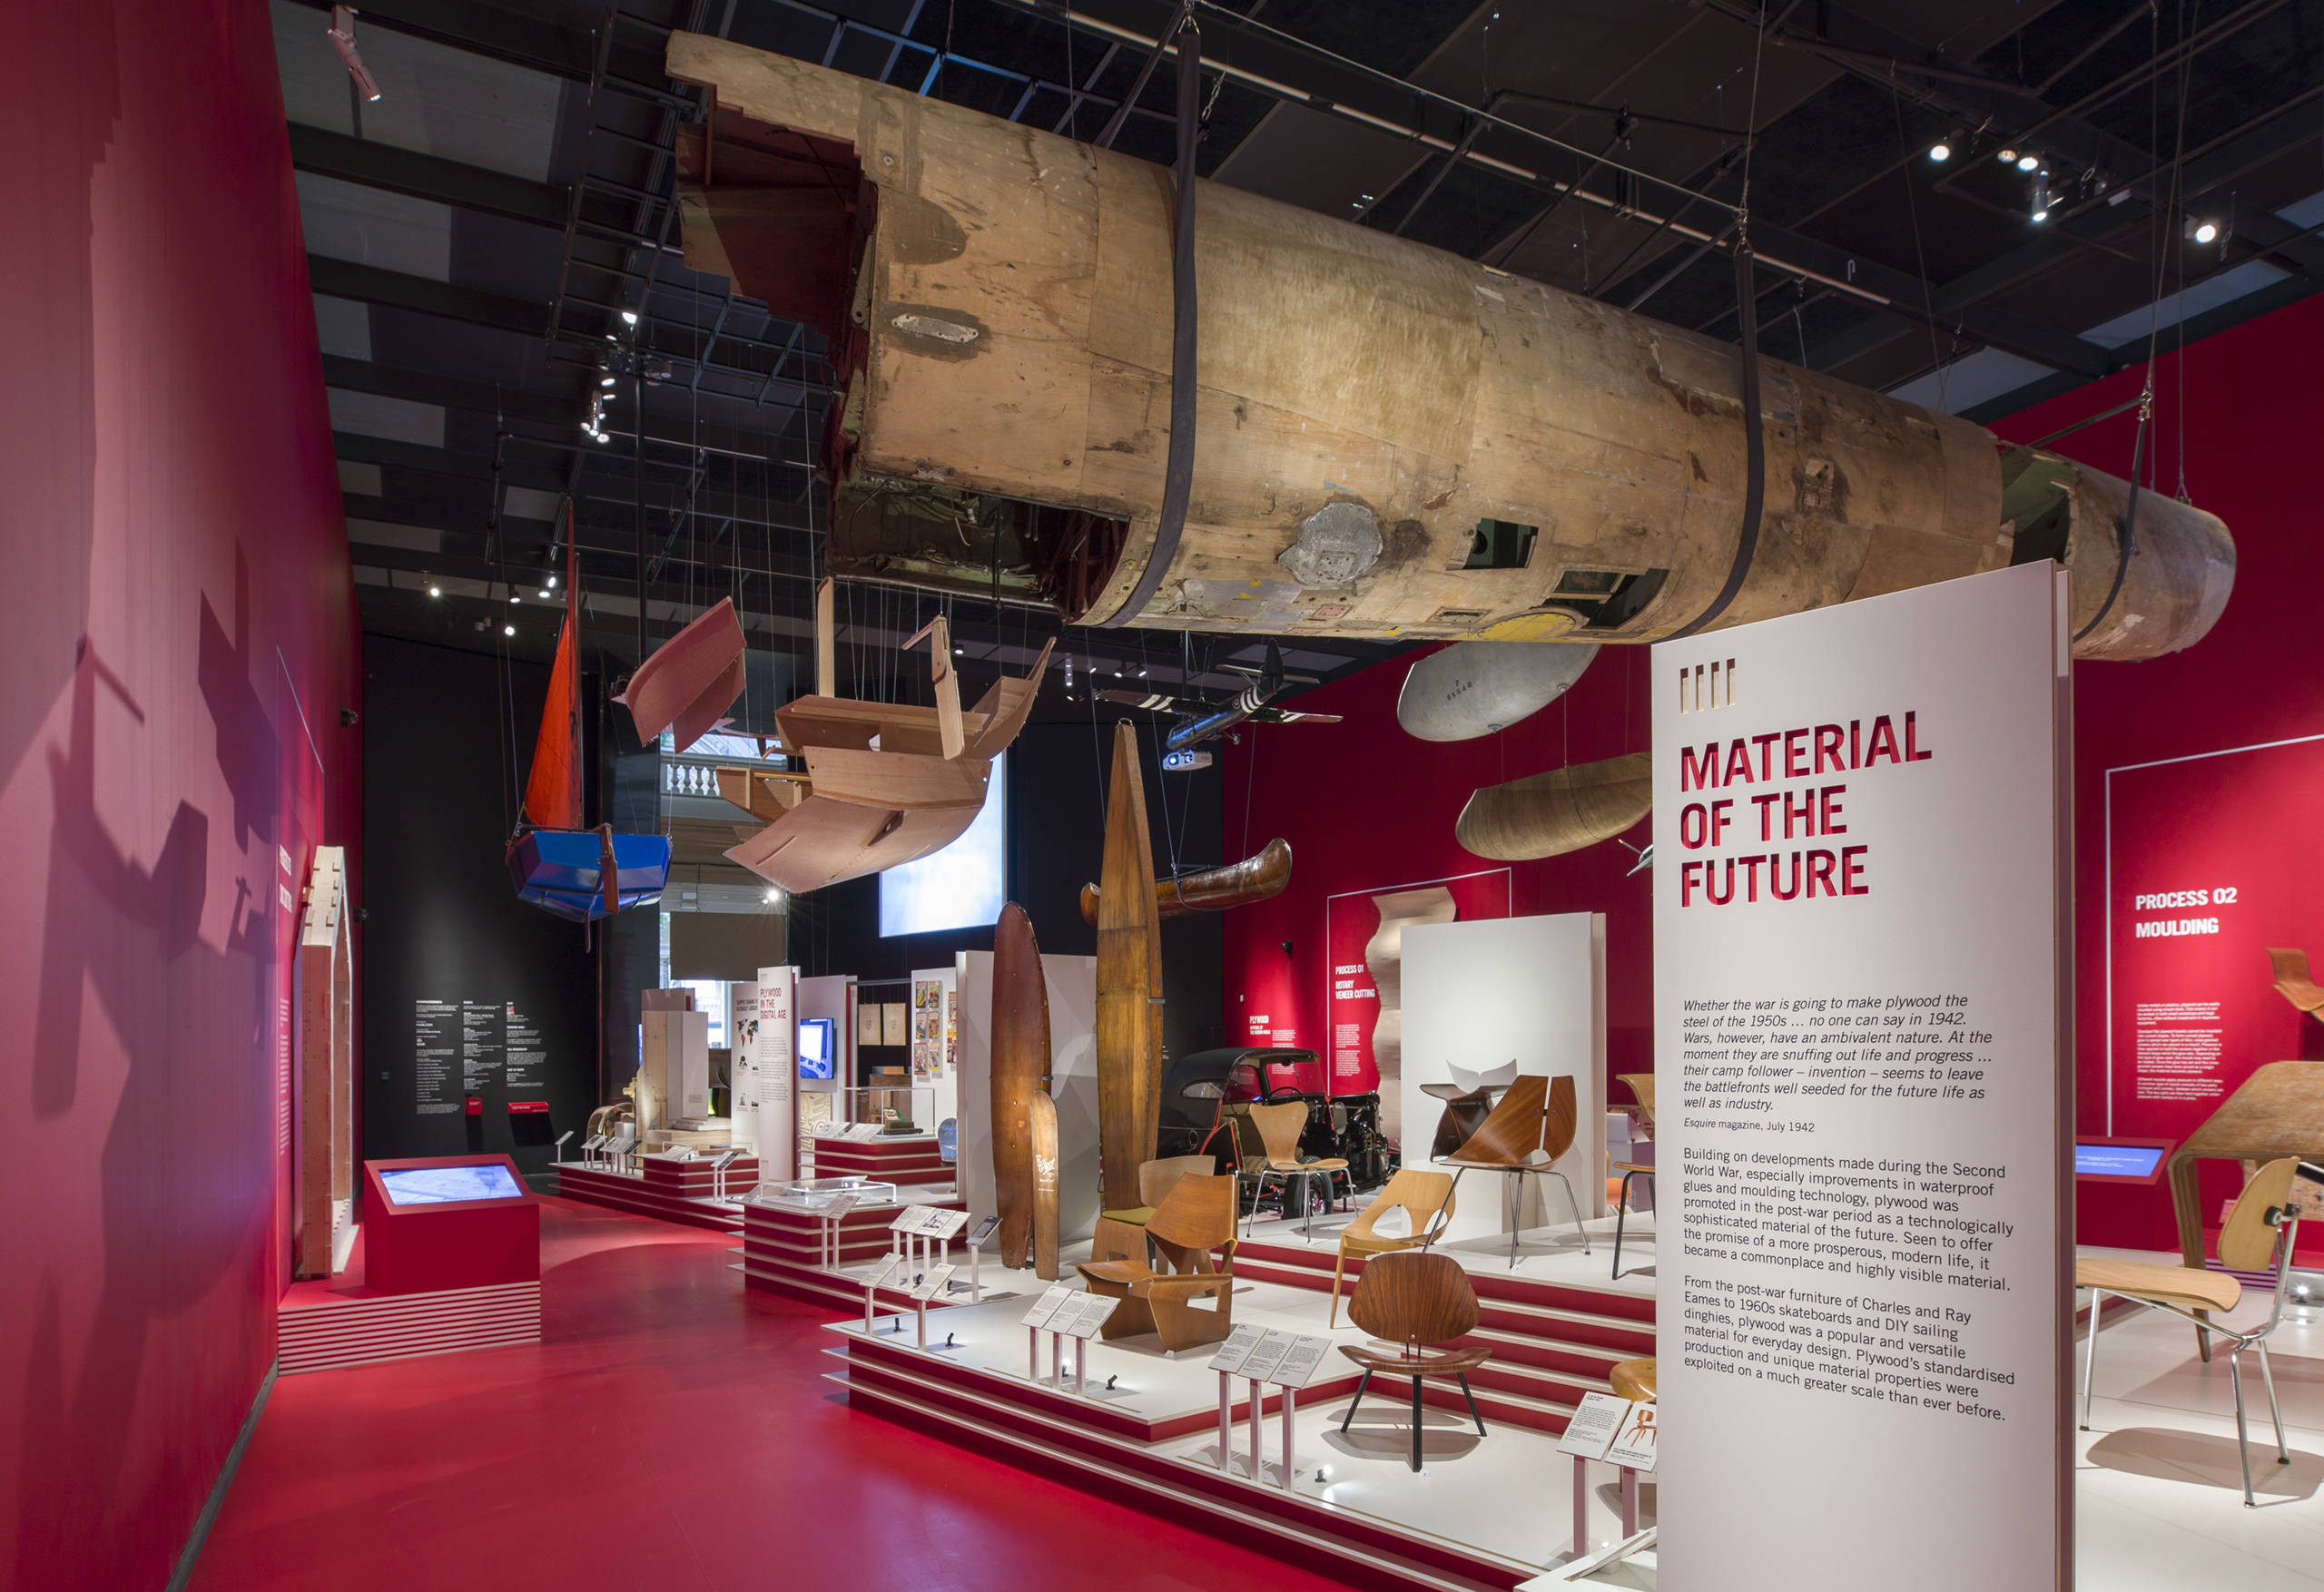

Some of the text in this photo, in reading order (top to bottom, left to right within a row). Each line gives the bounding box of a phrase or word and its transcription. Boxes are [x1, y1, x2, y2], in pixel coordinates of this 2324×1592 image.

[1681, 711, 1932, 792] MATERIAL
[1680, 784, 1847, 850] OF THE
[1681, 845, 1869, 908] FUTURE
[2135, 887, 2238, 910] PROCESS 02
[2135, 917, 2220, 938] MOULDING
[1335, 964, 1364, 975] PROCESS 01
[760, 988, 782, 998] PLYWOOD
[766, 999, 775, 1008] THE
[1335, 988, 1375, 999] VENEER CUTTING
[1685, 995, 1967, 1012] Whether the war is going to make plywood the
[760, 1009, 787, 1019] DIGITAL AGE
[1683, 1012, 1965, 1028] steel of the 1950s no one can say in 1942.
[1685, 1031, 1992, 1045] Wars, however, have an ambivalent nature. At the
[1684, 1048, 1973, 1064] moment they are snuffing out life and progress
[1684, 1065, 1984, 1080] their camp follower invention seems to leave
[1684, 1081, 1984, 1098] the battlefronts well seeded for the future life as
[1685, 1097, 1772, 1112] well as industry.
[1684, 1118, 1814, 1133] Esquire magazine, July 1942
[1684, 1147, 2004, 1178] Building on developments made during the Second
[1684, 1164, 1994, 1196] World War, especially improvements in waterproof
[1684, 1180, 1958, 1212] glues and moulding technology, plywood was
[1685, 1198, 2014, 1237] promoted in the post-war period as a technologically
[1684, 1214, 1993, 1251] sophisticated material of the future. Seen to offer
[1684, 1228, 1990, 1270] the promise of a more prosperous, modern life, it
[1685, 1243, 2010, 1291] became a commonplace and highly visible material.
[1685, 1275, 1971, 1325] From the post-war furniture of Charles and Ray
[1685, 1292, 1958, 1342] Eames to 1960s skateboards and DIY sailing
[1685, 1308, 1965, 1359] dinghies, plywood was a popular and versatile
